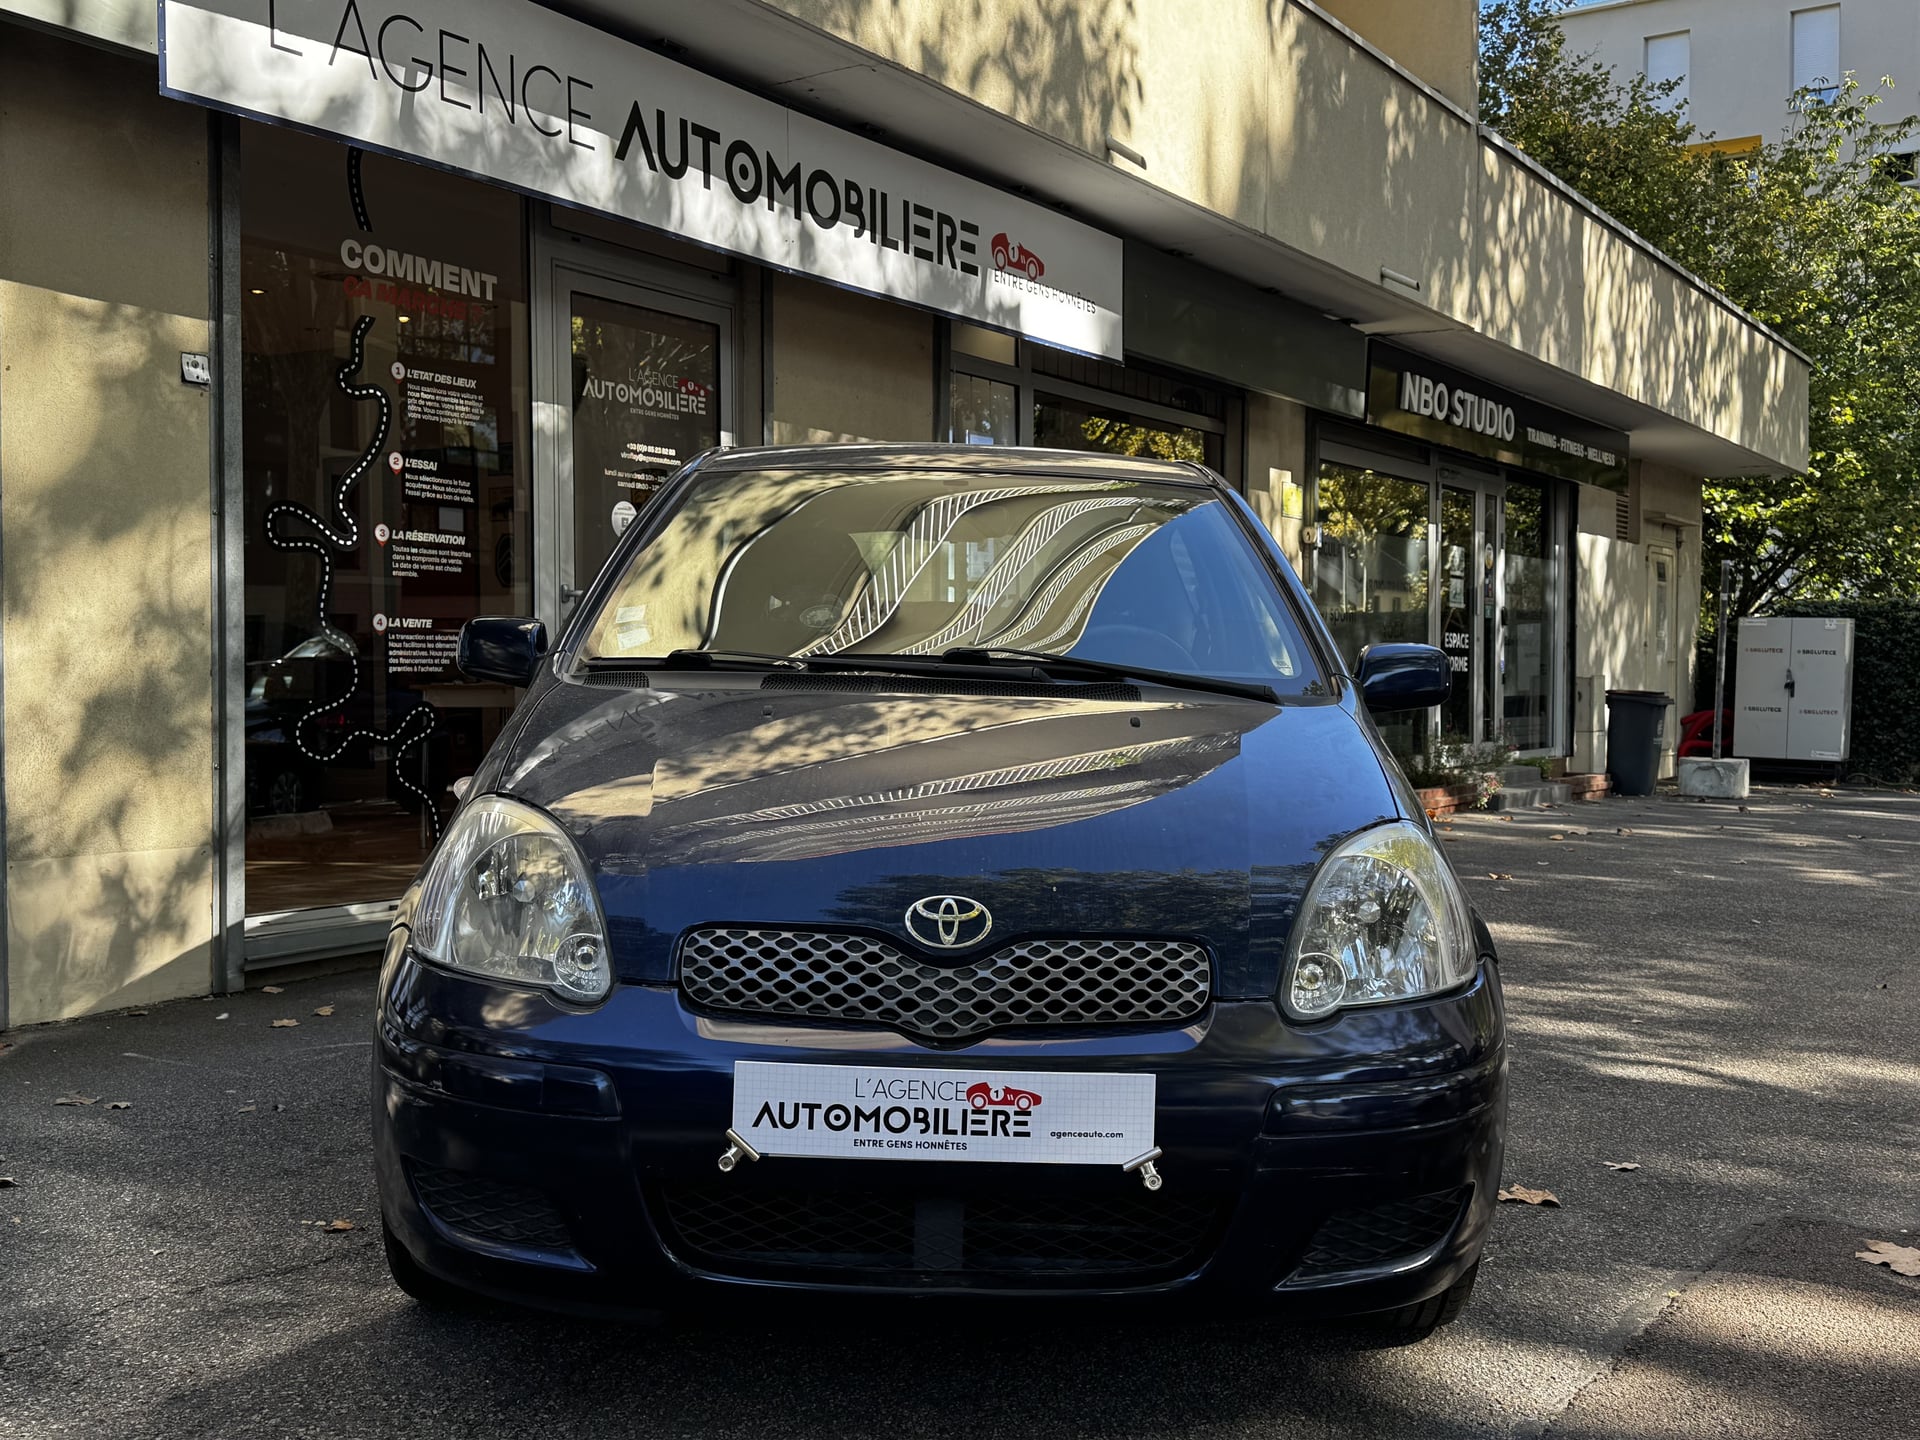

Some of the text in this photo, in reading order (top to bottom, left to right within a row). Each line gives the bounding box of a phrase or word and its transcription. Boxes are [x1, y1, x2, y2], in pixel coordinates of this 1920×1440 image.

[340, 239, 497, 301] COMMENT
[994, 268, 1096, 314] ENTRE GENS HONNÊTES
[407, 368, 477, 389] L'ETAT DES LIEUX
[1400, 371, 1515, 442] NBO STUDIO
[1526, 427, 1557, 449] TRAINING
[1560, 438, 1584, 457] FITNESS
[1587, 446, 1615, 467] WELLNESS
[405, 458, 438, 471] L'ESSAI
[392, 529, 466, 545] LA RÉSERVATION
[388, 618, 433, 629] LA VENTE
[1445, 632, 1469, 648] ESPACE
[1448, 656, 1468, 672] ORME
[855, 1078, 968, 1101] L'AGENCE
[1050, 1130, 1124, 1139] agenceauto.com
[854, 1138, 968, 1150] ENTRE GENS HONNÊTES
